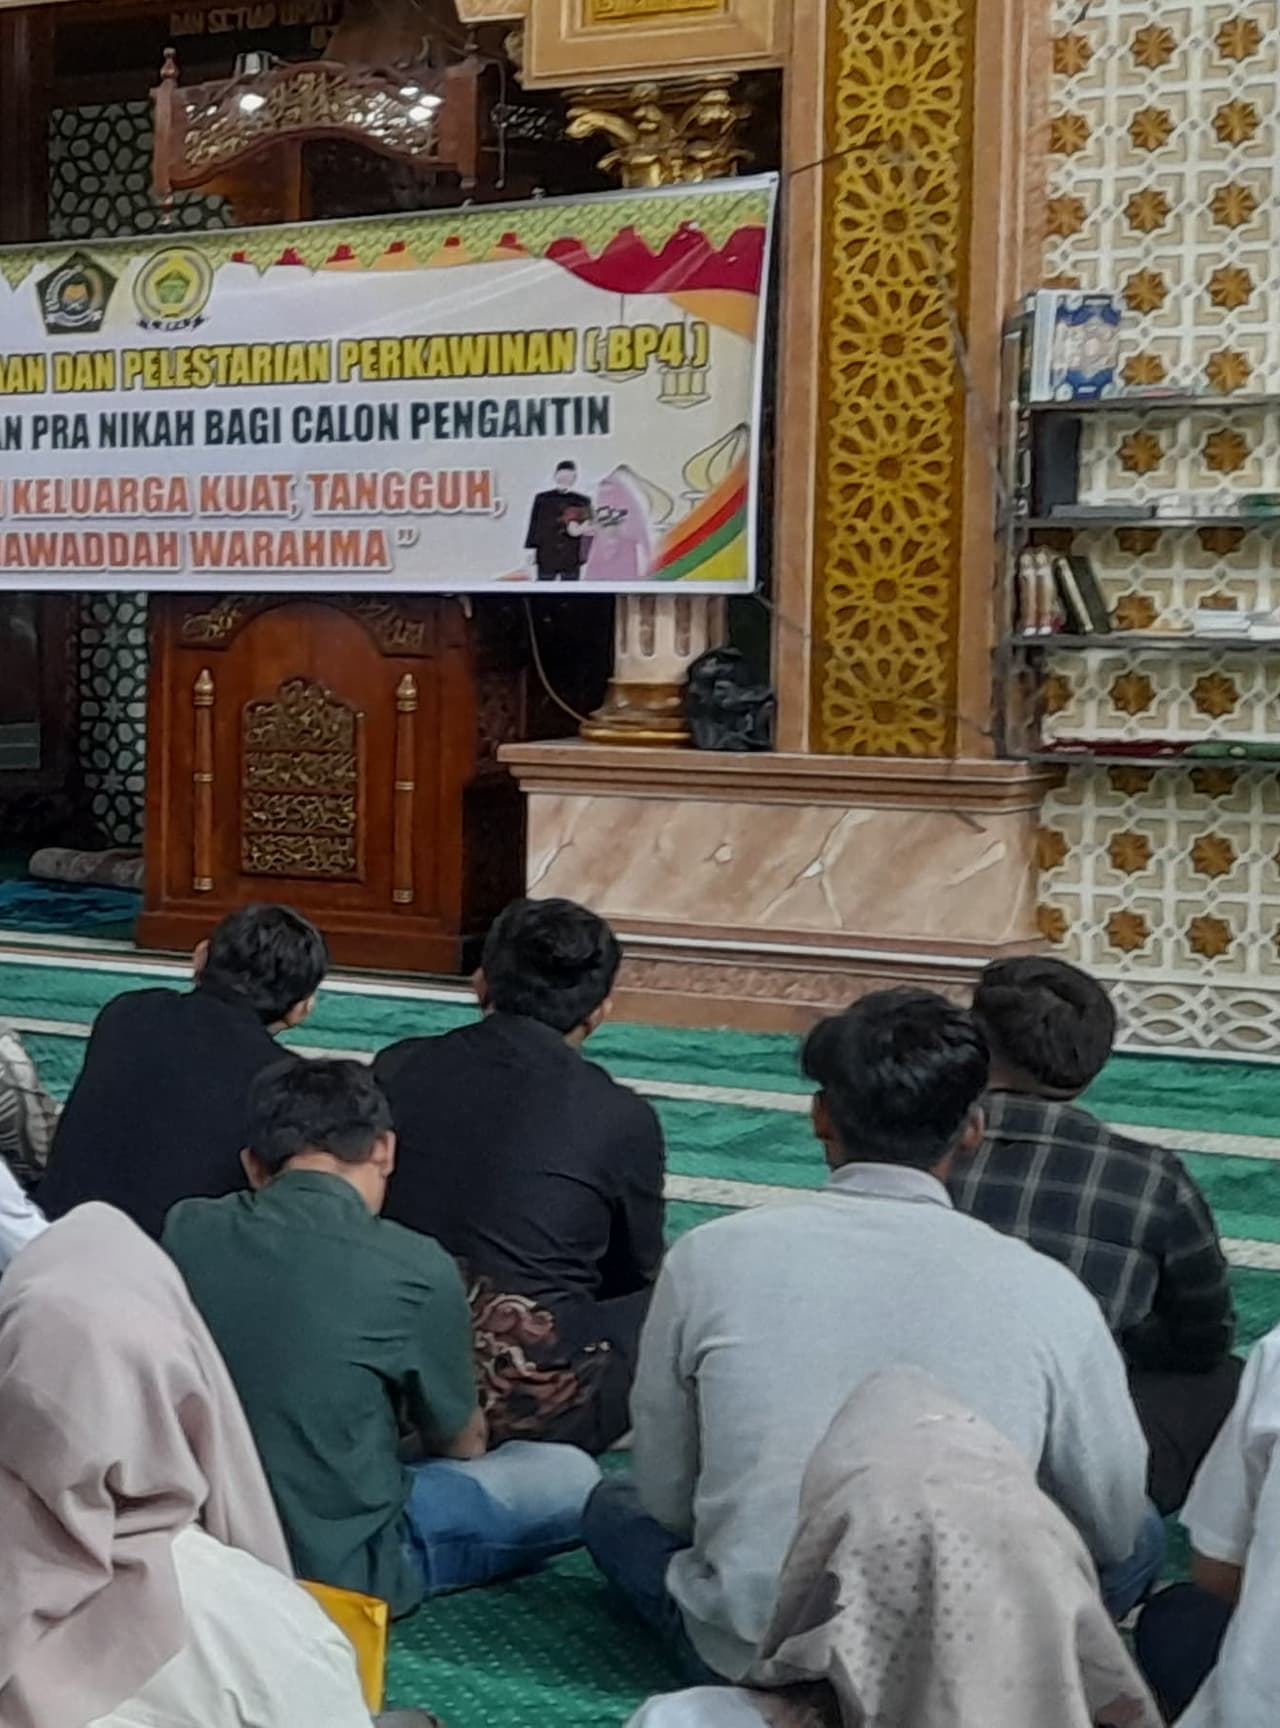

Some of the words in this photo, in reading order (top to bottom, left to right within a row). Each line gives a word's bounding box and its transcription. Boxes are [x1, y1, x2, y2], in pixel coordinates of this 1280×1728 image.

[53, 350, 116, 393] DAN
[122, 341, 330, 388] PELESTARIAN
[337, 328, 577, 383] PERKAWINAN
[32, 413, 90, 449] PRA
[97, 409, 195, 449] NIKAH
[204, 406, 282, 446] BAGI
[292, 404, 399, 443] CALON
[409, 396, 611, 440] PENGANTIN
[11, 476, 190, 516] KELUARGA
[199, 474, 301, 520] KUAT,
[309, 470, 505, 517] TANGGUH,
[190, 529, 390, 568] WARAHMA
